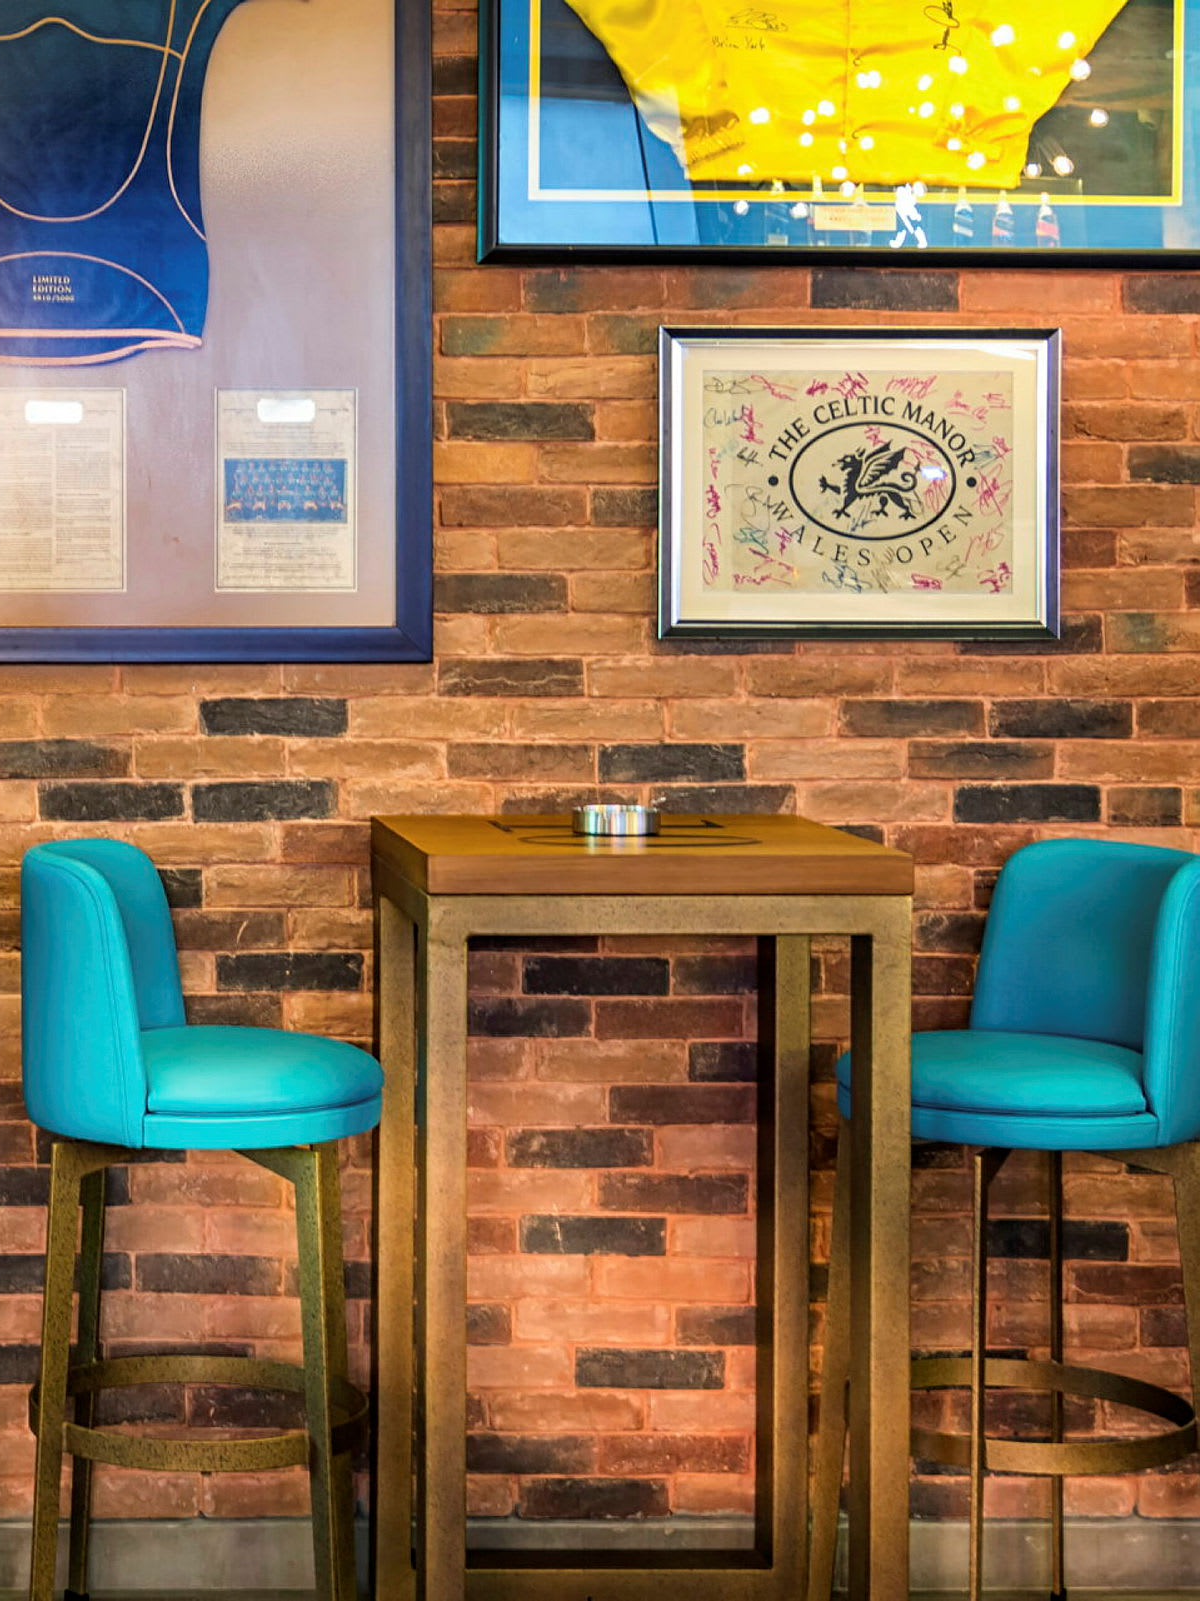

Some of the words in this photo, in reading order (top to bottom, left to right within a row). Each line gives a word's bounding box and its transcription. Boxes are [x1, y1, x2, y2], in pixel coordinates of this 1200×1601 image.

[33, 275, 70, 284] LIMITED
[33, 285, 72, 294] EDITION
[769, 417, 811, 462] THE
[813, 395, 896, 424] CELTIC
[901, 400, 977, 468] MANOR
[771, 501, 871, 566] WALES
[896, 505, 975, 565] OPEN
